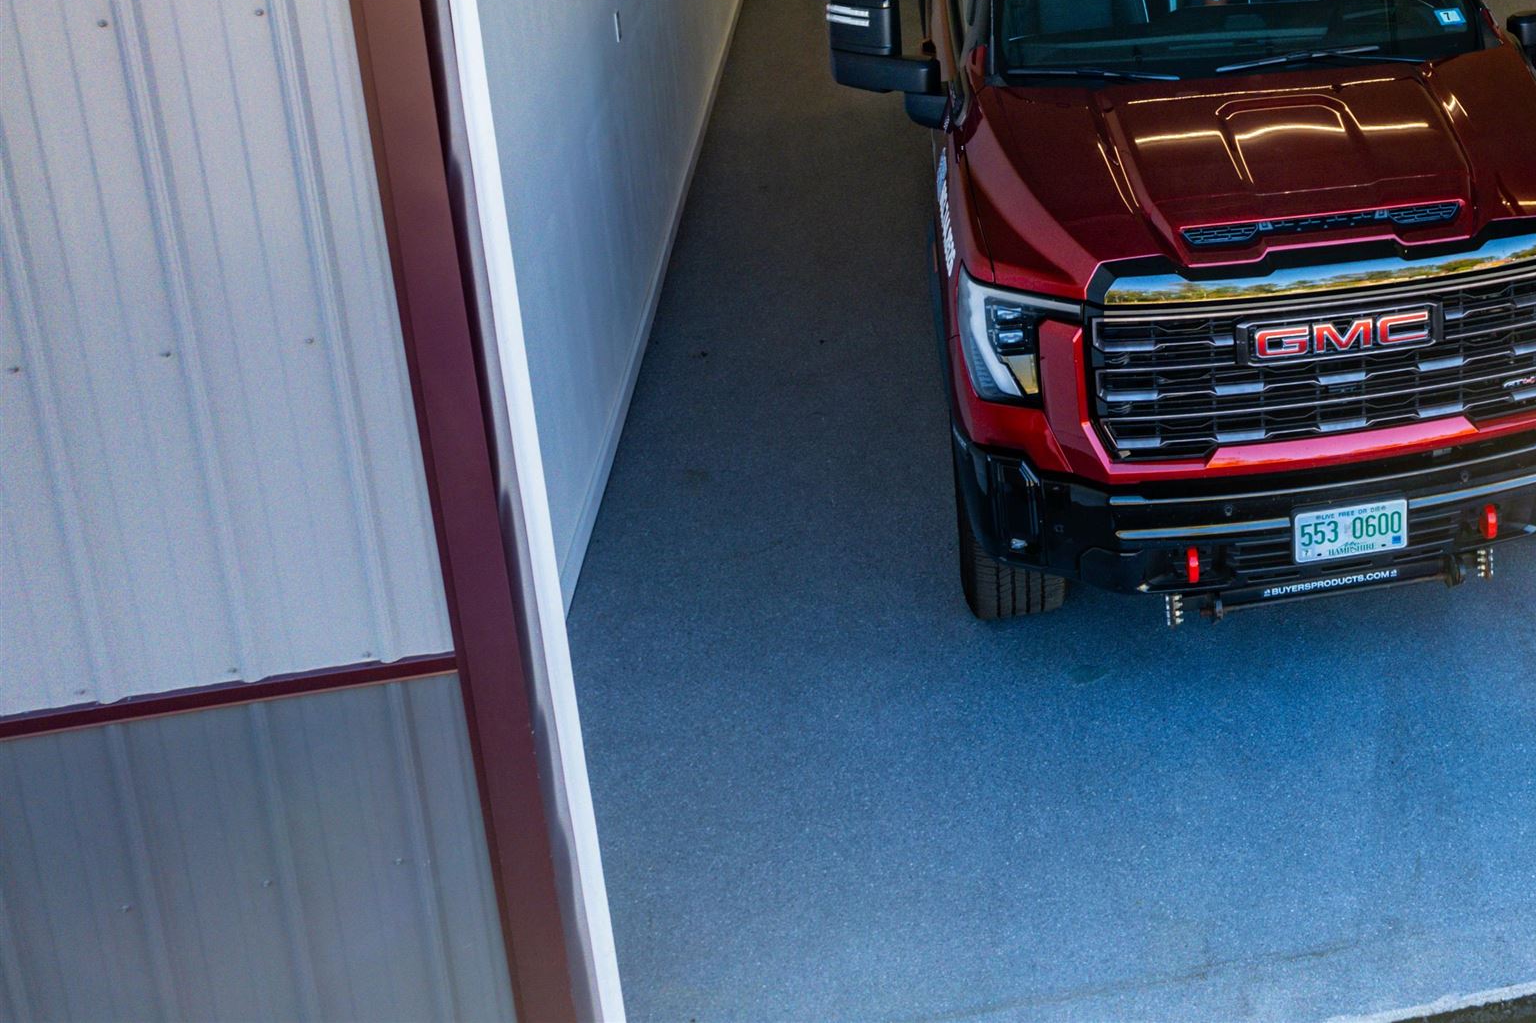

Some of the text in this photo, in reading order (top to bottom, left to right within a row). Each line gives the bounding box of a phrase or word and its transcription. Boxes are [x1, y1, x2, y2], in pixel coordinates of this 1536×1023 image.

[1255, 310, 1429, 358] GMC
[1300, 510, 1402, 547] 553 0600
[1338, 509, 1355, 517] FREE
[1271, 570, 1390, 595] BUYERSPRODUCTS.COM
